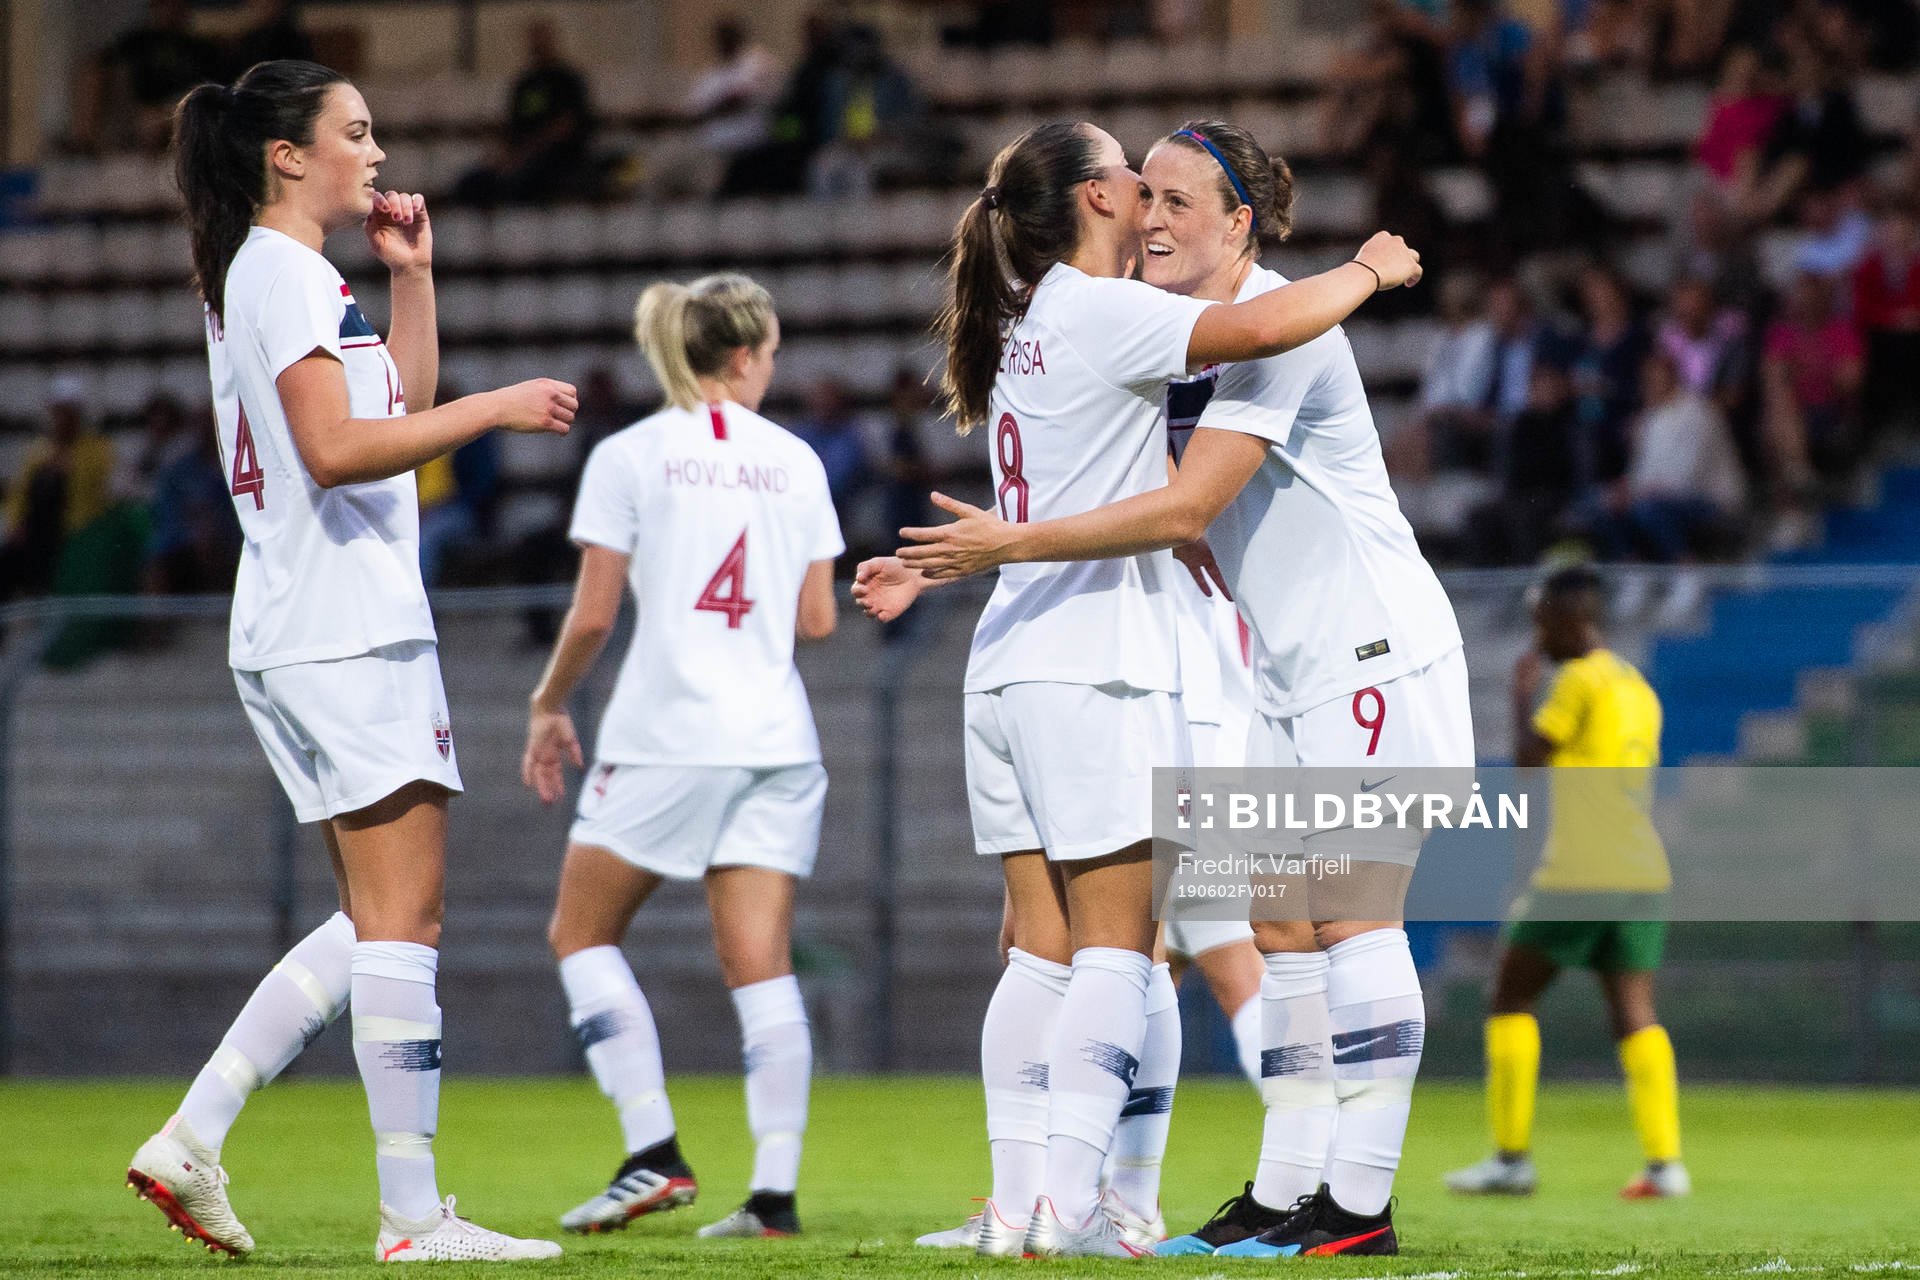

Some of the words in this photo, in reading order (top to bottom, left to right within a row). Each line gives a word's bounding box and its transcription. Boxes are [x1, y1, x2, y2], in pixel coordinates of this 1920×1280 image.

[213, 392, 264, 512] 4
[665, 459, 789, 493] HOVLAND
[997, 412, 1029, 523] 8
[694, 525, 755, 629] 4
[1352, 686, 1386, 757] 9
